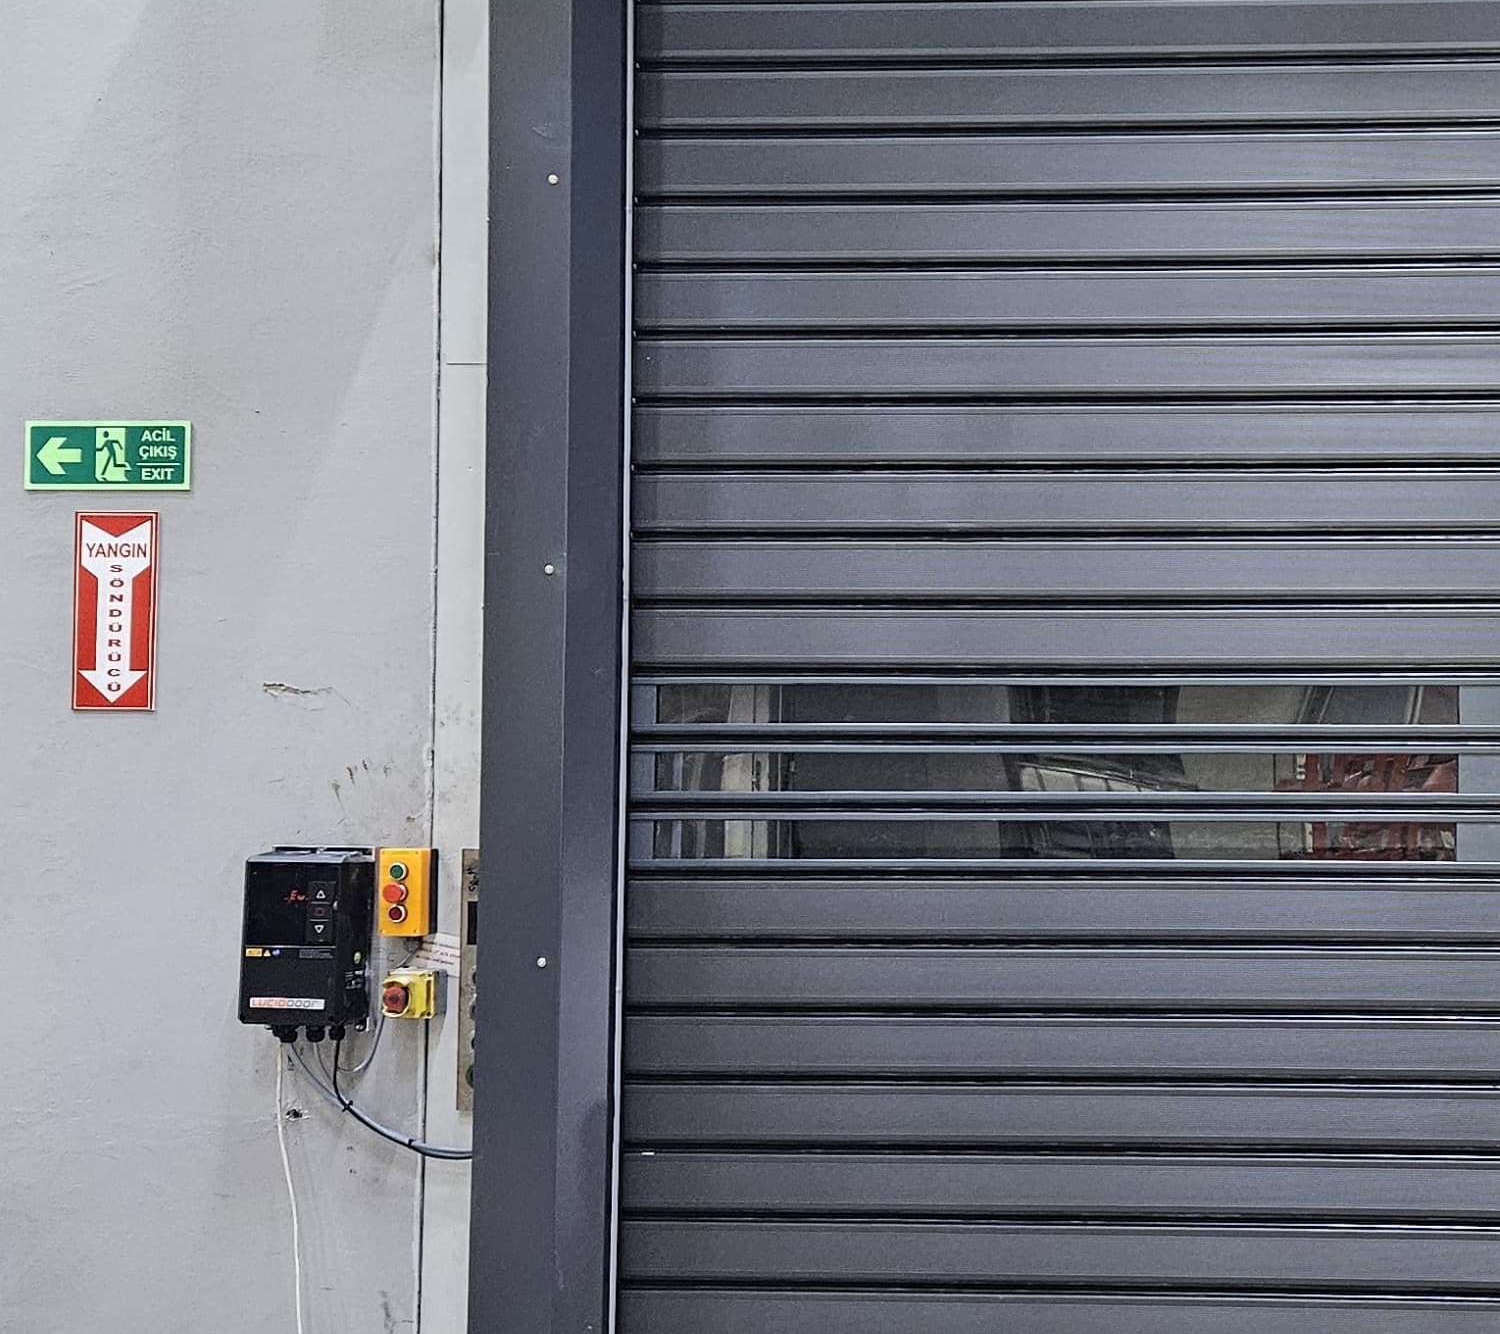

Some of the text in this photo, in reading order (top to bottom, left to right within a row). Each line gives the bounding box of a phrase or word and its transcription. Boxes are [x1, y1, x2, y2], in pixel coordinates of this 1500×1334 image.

[141, 428, 176, 442] ACİL
[139, 445, 177, 461] ÇIKIŞ
[141, 468, 174, 481] EXIT
[86, 543, 148, 558] YANGIN
[108, 564, 125, 692] SÖNDÜRÜCÜ
